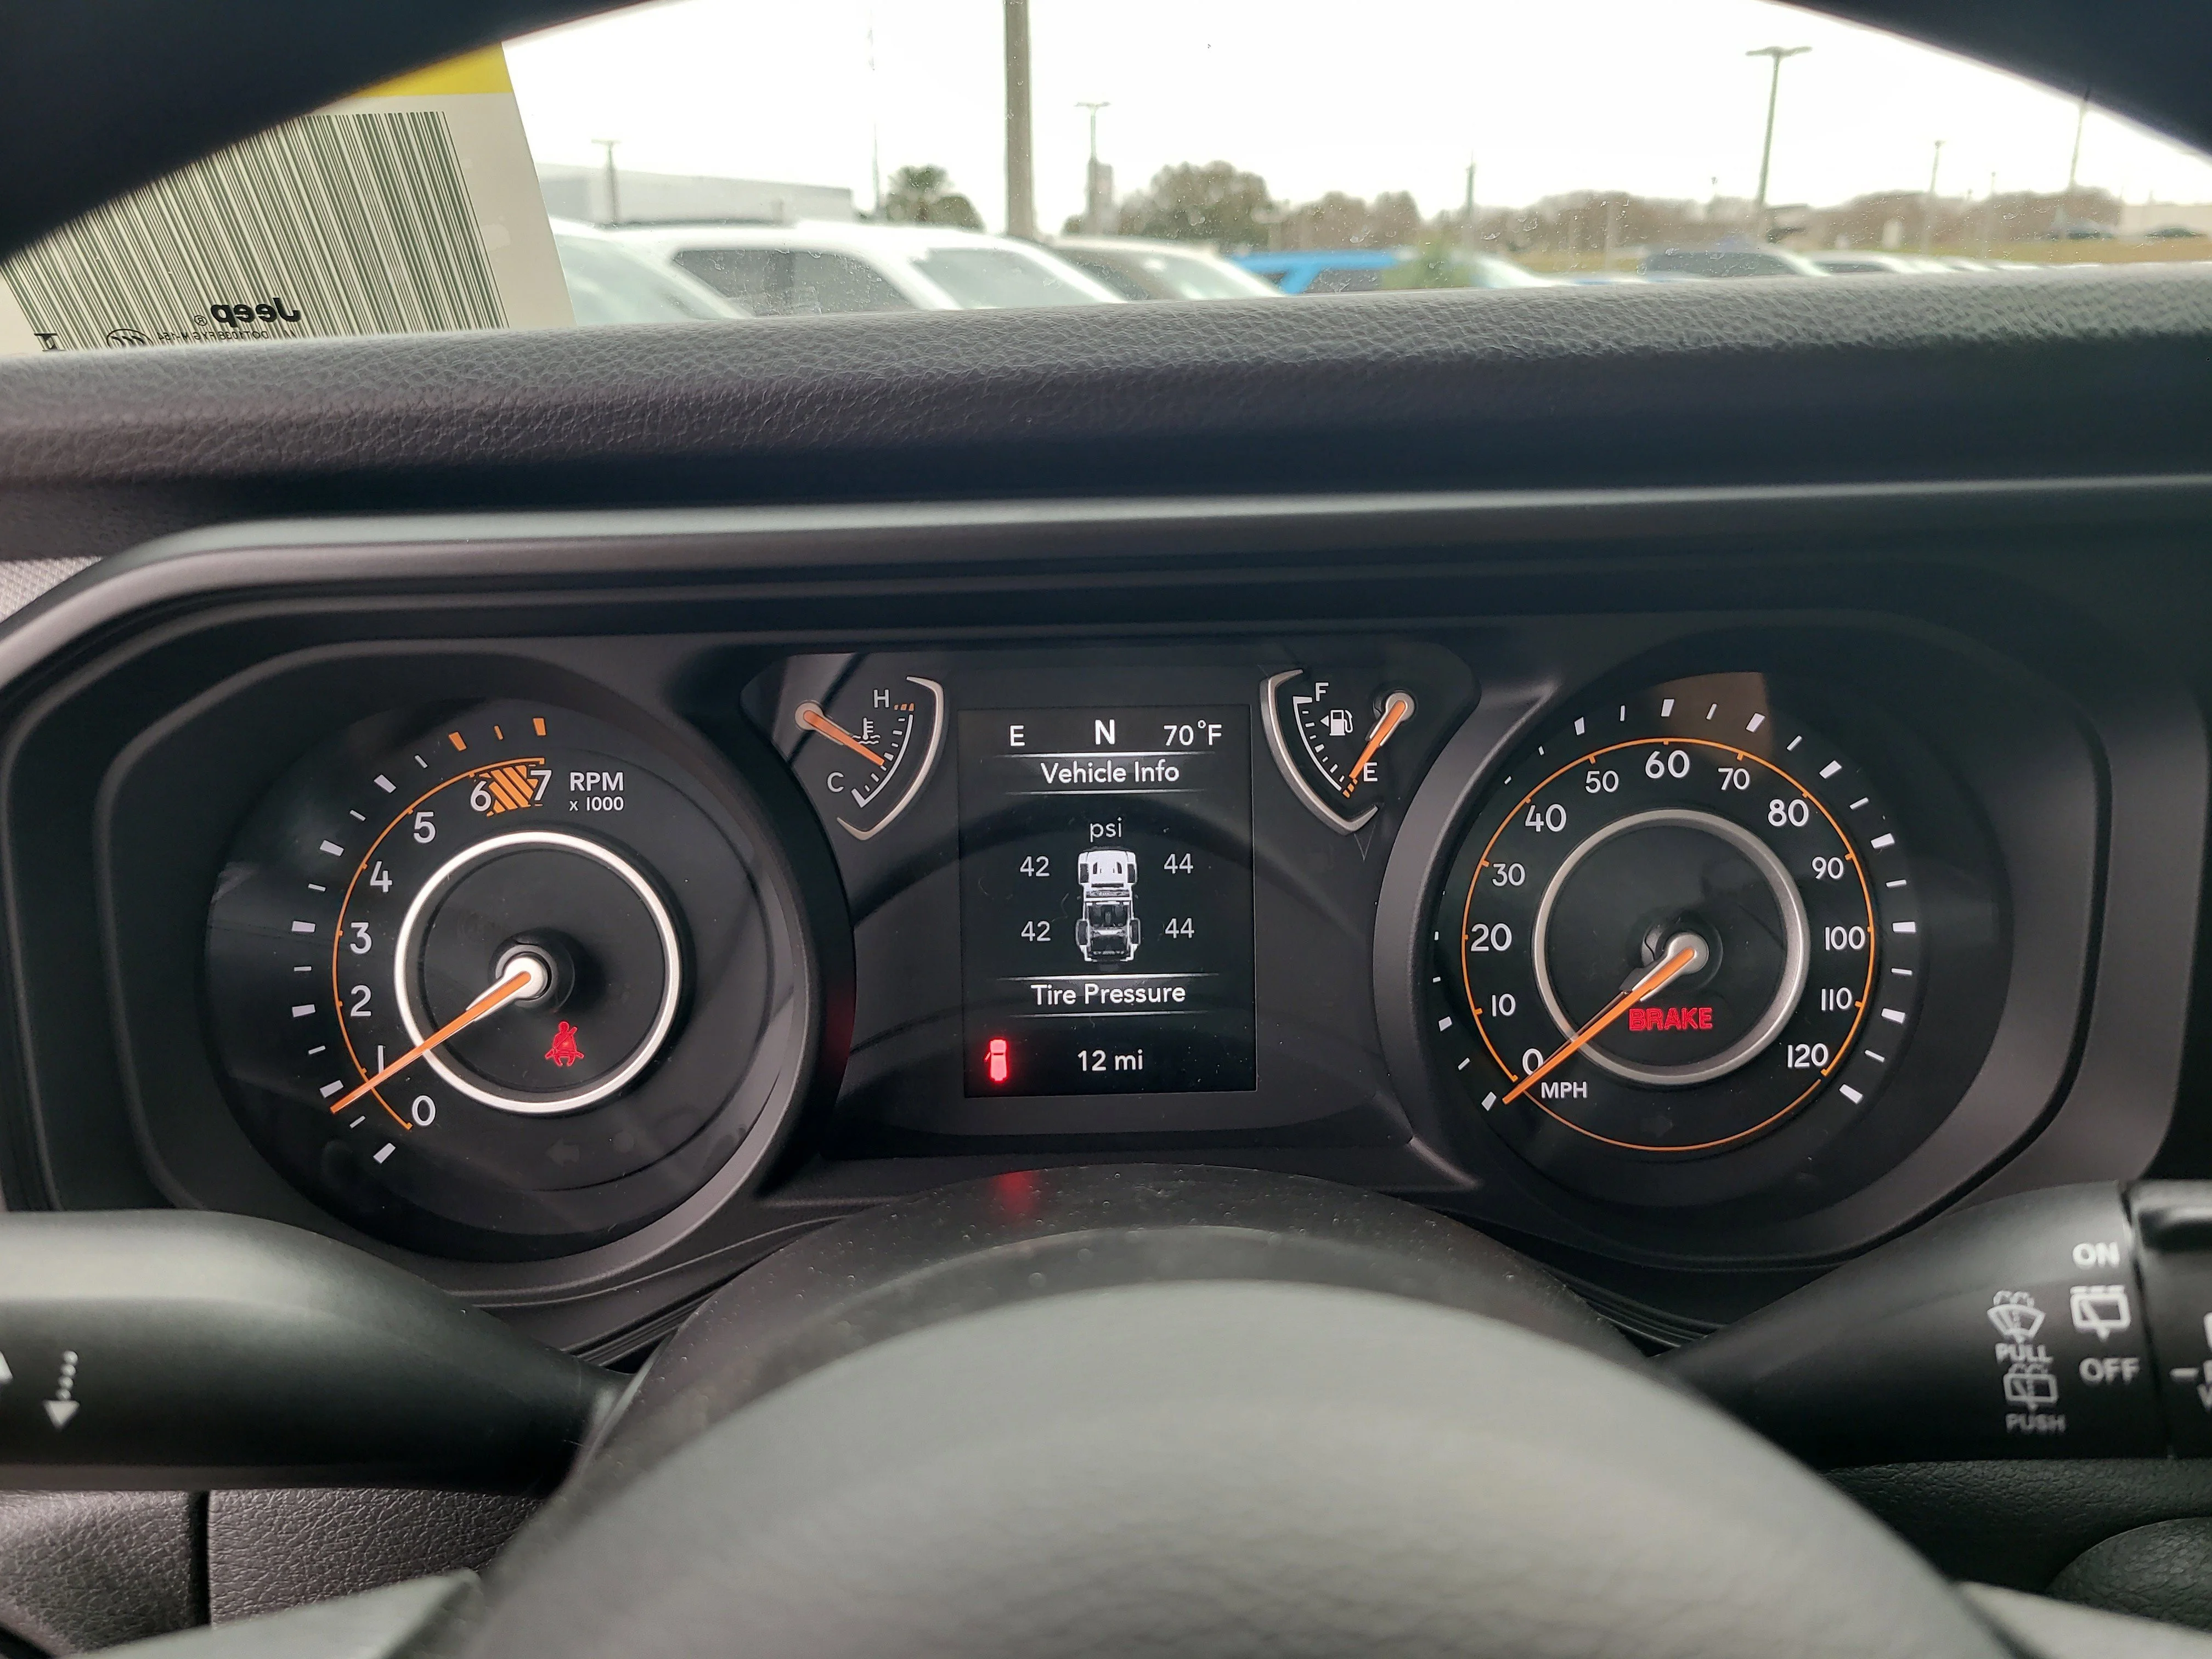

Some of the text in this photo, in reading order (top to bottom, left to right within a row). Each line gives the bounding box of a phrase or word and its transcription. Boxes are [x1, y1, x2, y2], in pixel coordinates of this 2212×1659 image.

[873, 689, 889, 708] H
[1315, 682, 1329, 702] F
[1010, 725, 1025, 747] E
[1095, 719, 1115, 745] N
[1164, 720, 1222, 746] 70°F
[1040, 758, 1180, 784] Vehicle Info
[1363, 761, 1378, 782] E
[1645, 750, 1690, 779] 60
[530, 770, 552, 801] 7
[570, 771, 624, 791] RPM
[827, 771, 844, 792] C
[1585, 770, 1619, 793] 50
[1718, 768, 1750, 791] 70
[470, 781, 492, 811] 6
[569, 796, 624, 811] x 1000
[1525, 804, 1567, 832] 40
[1768, 799, 1809, 827] 80
[414, 811, 436, 844] 5
[1090, 817, 1122, 842] psi
[1020, 856, 1050, 877] 42
[1164, 853, 1194, 874] 44
[1492, 863, 1526, 887] 30
[1812, 856, 1844, 879] 90
[370, 861, 393, 893] 4
[350, 922, 372, 954] 3
[1021, 921, 1051, 941] 42
[1165, 918, 1195, 939] 44
[1471, 923, 1512, 951] 20
[1825, 926, 1865, 950] 100
[350, 985, 371, 1017] 2
[1030, 983, 1186, 1005] Tire Pressure
[1492, 994, 1516, 1017] 10
[1821, 987, 1853, 1011] 110
[1628, 1007, 1713, 1031] BRAKE
[1077, 1049, 1143, 1071] 12 mi
[1522, 1048, 1544, 1076] 0
[1787, 1043, 1829, 1068] 120
[1541, 1081, 1588, 1099] MPH
[411, 1095, 436, 1126] 0
[2072, 1241, 2121, 1268] ON
[1995, 1342, 2053, 1364] PULL
[2079, 1357, 2140, 1383] OFF
[2005, 1413, 2066, 1433] PUSH
